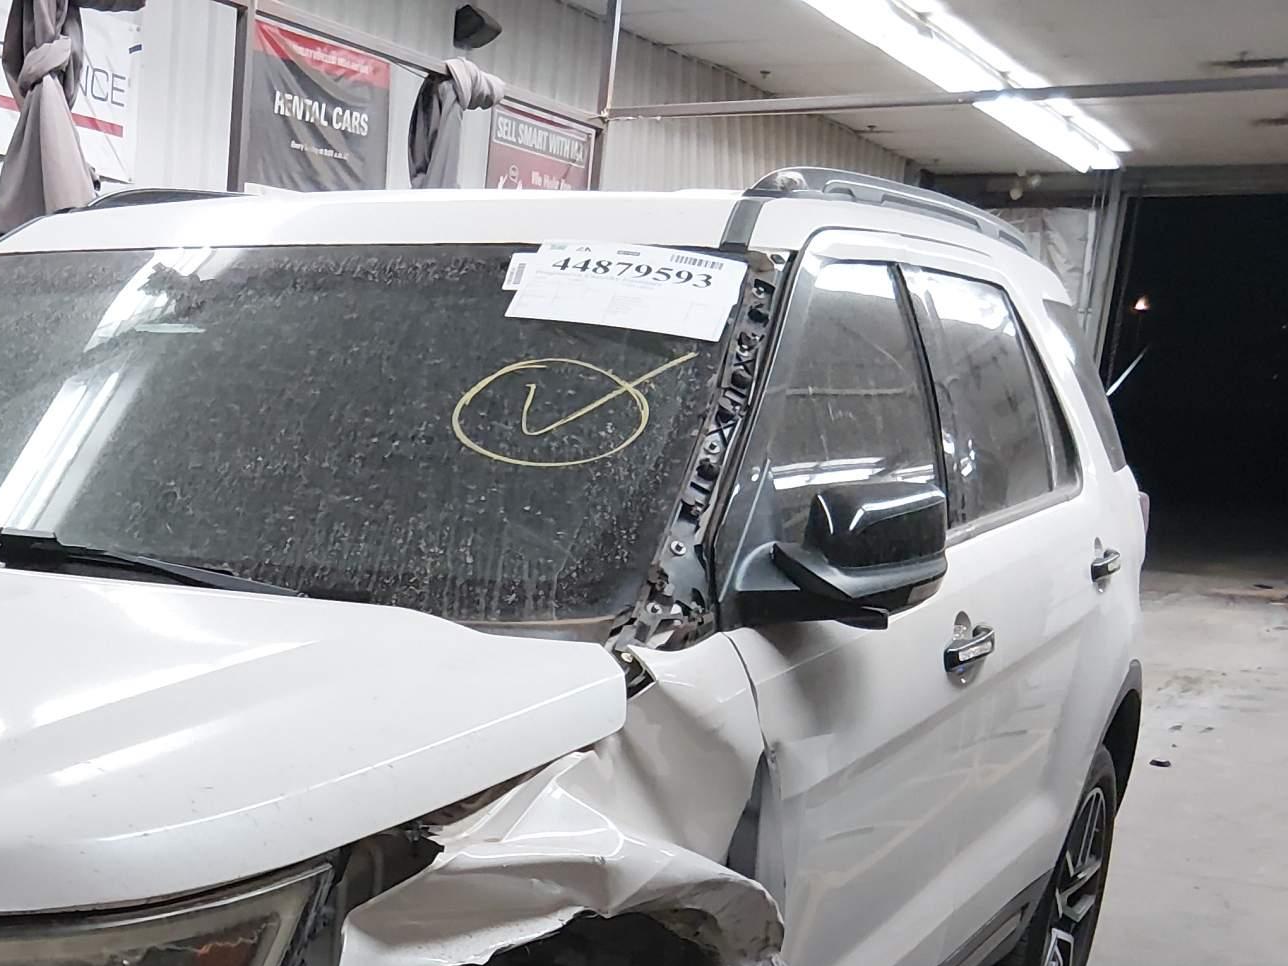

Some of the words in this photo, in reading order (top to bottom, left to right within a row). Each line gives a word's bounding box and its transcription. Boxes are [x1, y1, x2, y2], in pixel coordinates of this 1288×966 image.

[273, 90, 329, 127] RENTAL
[332, 106, 369, 136] CARS
[496, 116, 517, 142] SELL
[518, 123, 548, 151] SMART
[549, 133, 570, 159] WITH
[551, 256, 714, 289] 44879593
